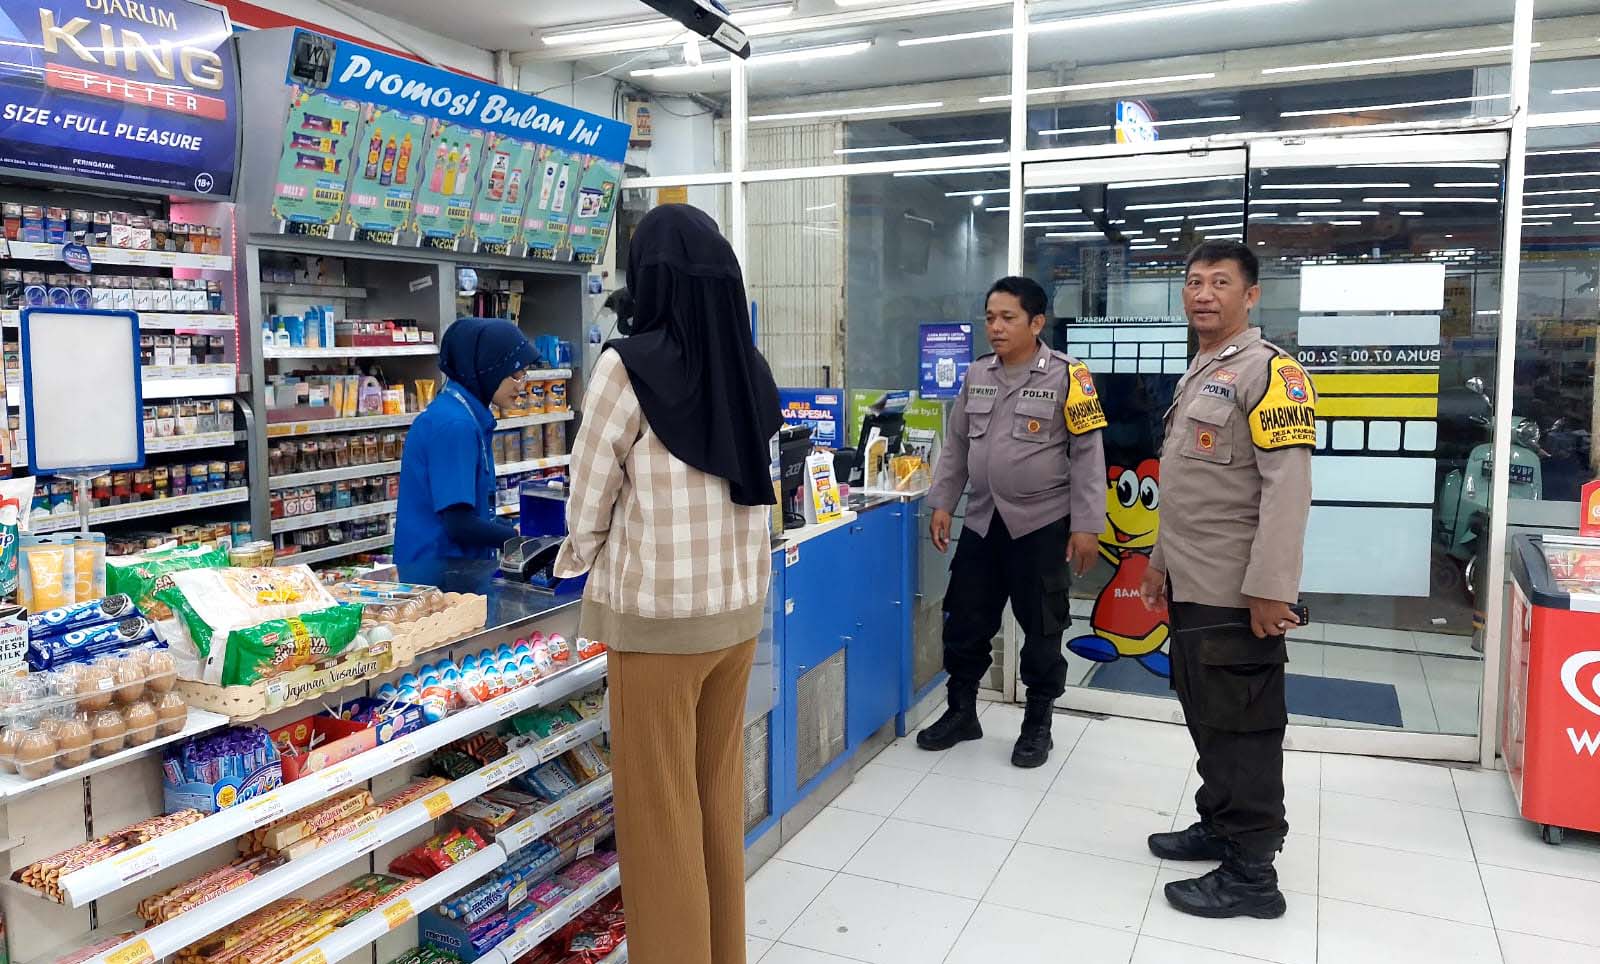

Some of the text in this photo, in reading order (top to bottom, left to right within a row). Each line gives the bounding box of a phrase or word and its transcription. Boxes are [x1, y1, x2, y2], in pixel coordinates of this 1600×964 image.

[39, 7, 224, 91] KING
[83, 75, 198, 112] FILTER
[339, 54, 602, 147] Promosi Bulan Ini
[3, 103, 203, 151] SIZE FULL PLEASURE
[197, 178, 211, 188] 18+
[316, 189, 339, 199] GRATIS
[386, 198, 406, 208] GRATIS
[298, 224, 329, 237] 17.600
[367, 231, 393, 244] 14.000
[1023, 390, 1054, 400] POLRI
[1203, 384, 1230, 398] POLRI
[781, 409, 834, 419] GA SPESIAL
[1272, 429, 1290, 437] DESA
[0, 641, 25, 652] RESH
[283, 677, 325, 701] Jajanan
[474, 893, 503, 916] mentos
[425, 930, 461, 947] mentos
